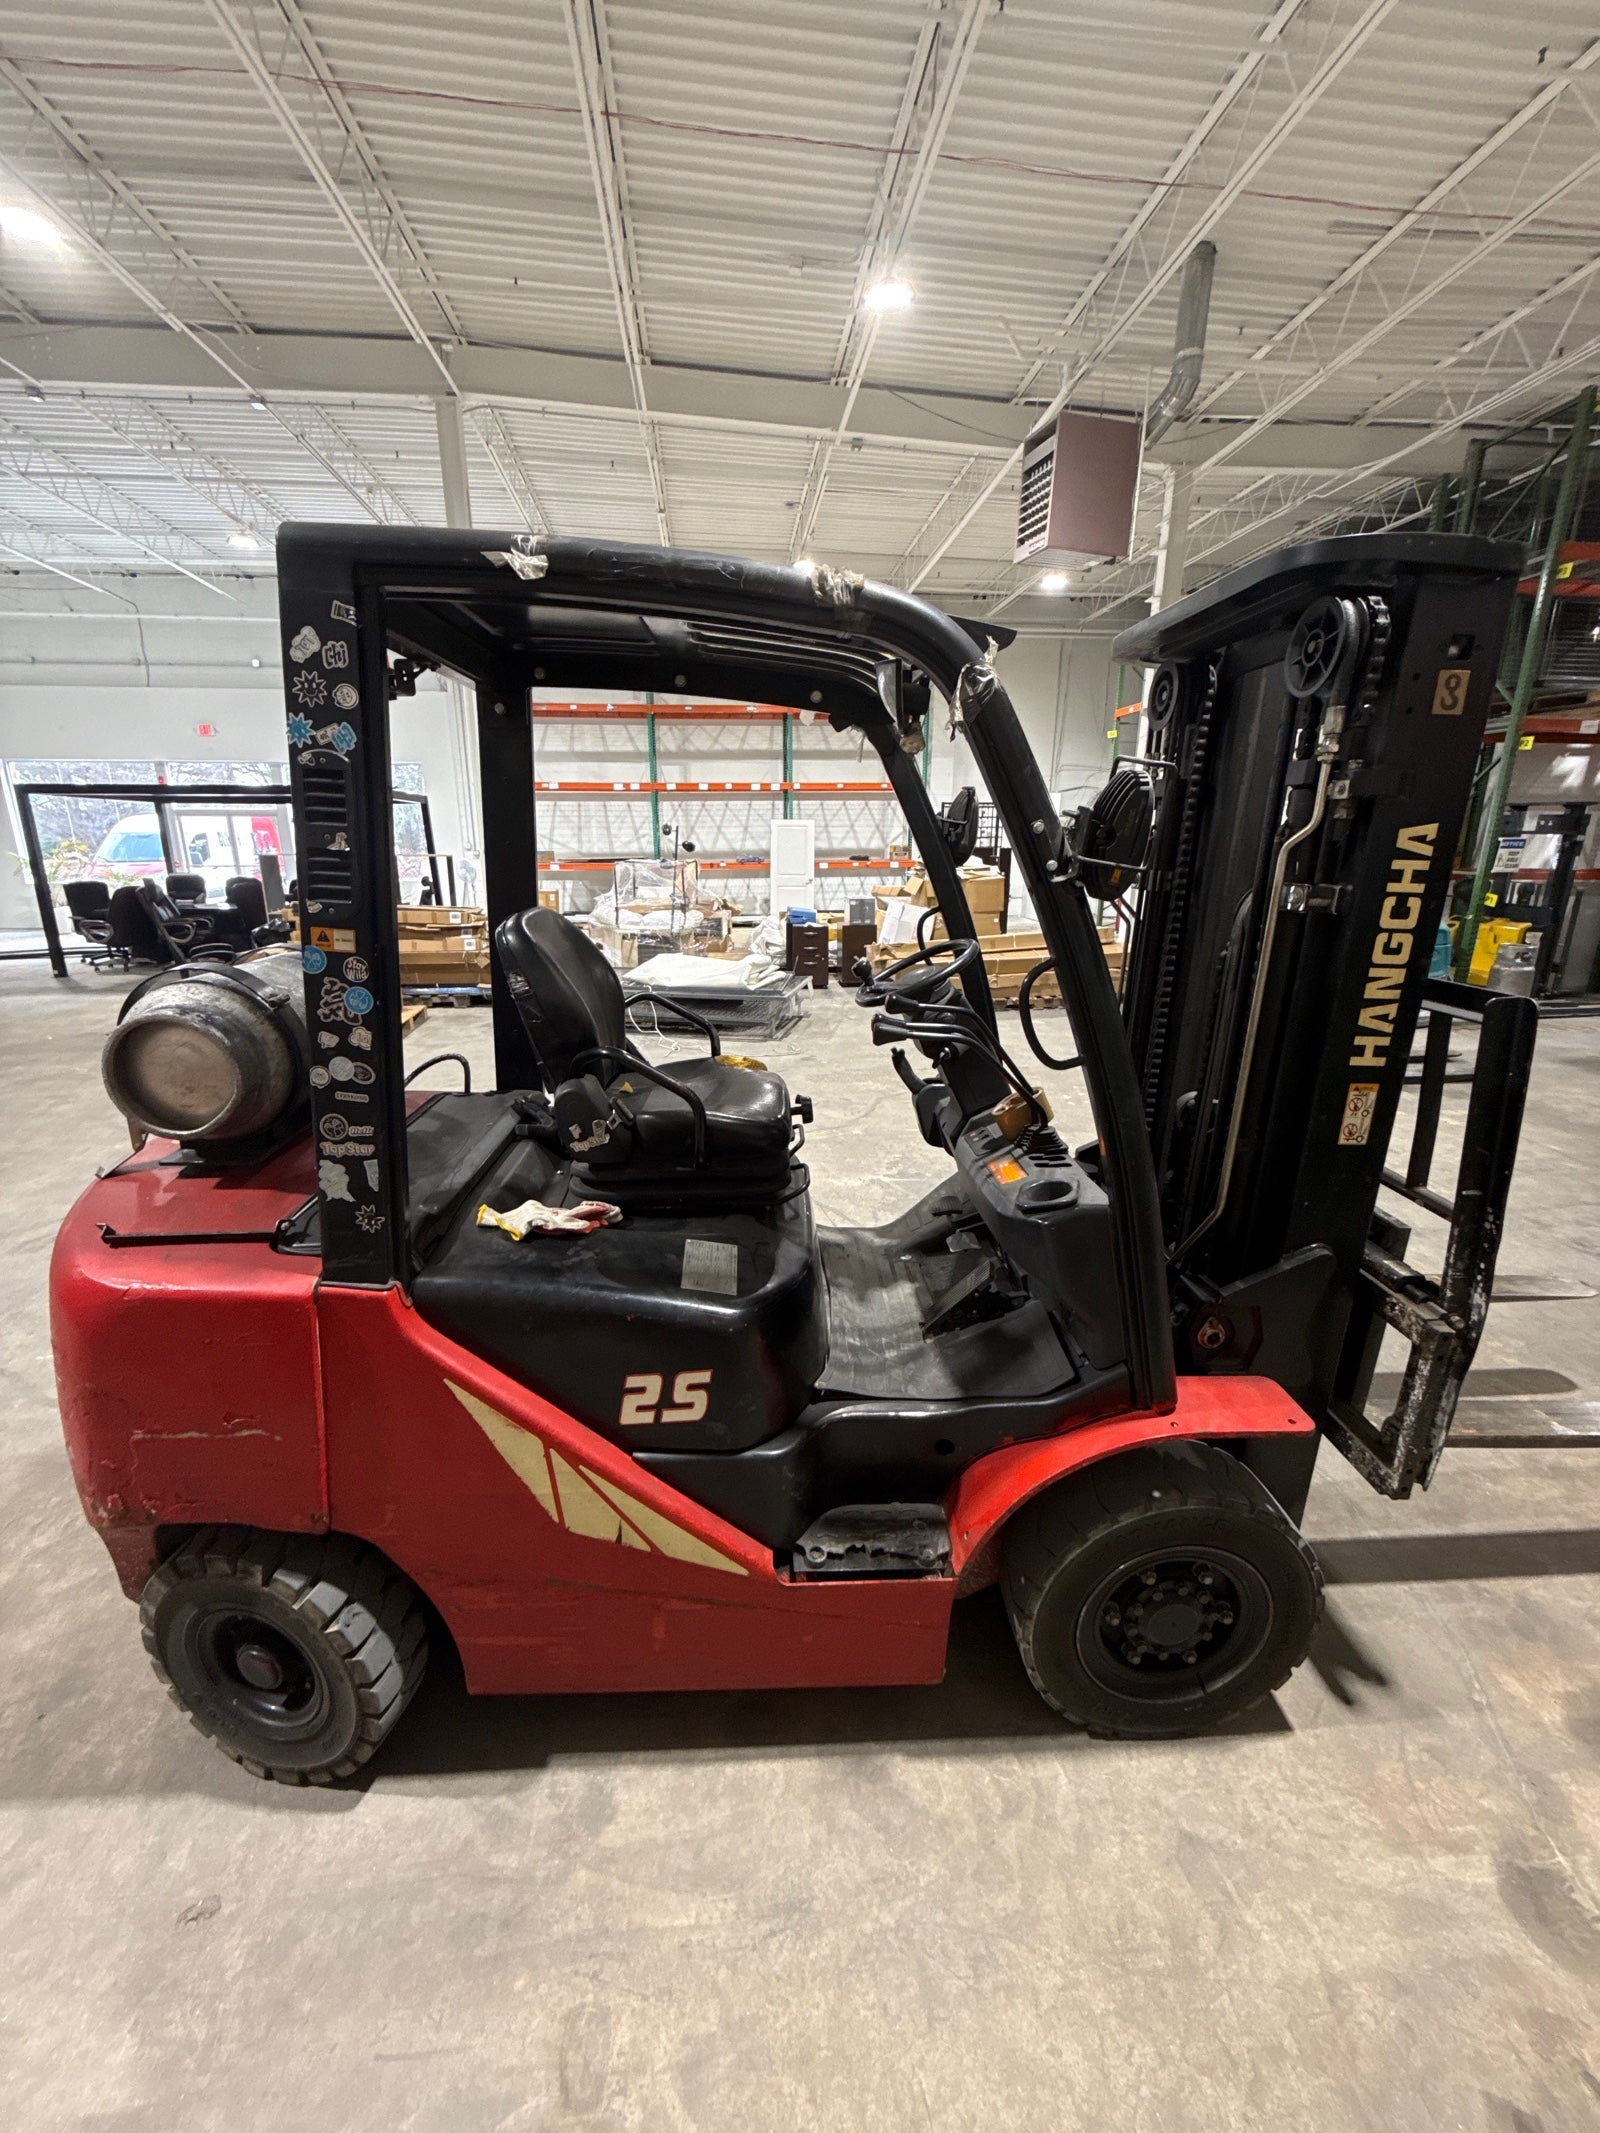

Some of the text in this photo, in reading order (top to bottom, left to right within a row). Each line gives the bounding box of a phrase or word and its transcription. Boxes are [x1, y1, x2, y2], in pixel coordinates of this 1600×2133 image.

[1349, 822, 1440, 1067] HANGCHA
[347, 957, 367, 972] Stay
[346, 968, 367, 980] Wild
[322, 1141, 374, 1156] Top Star
[619, 1369, 714, 1425] 25
